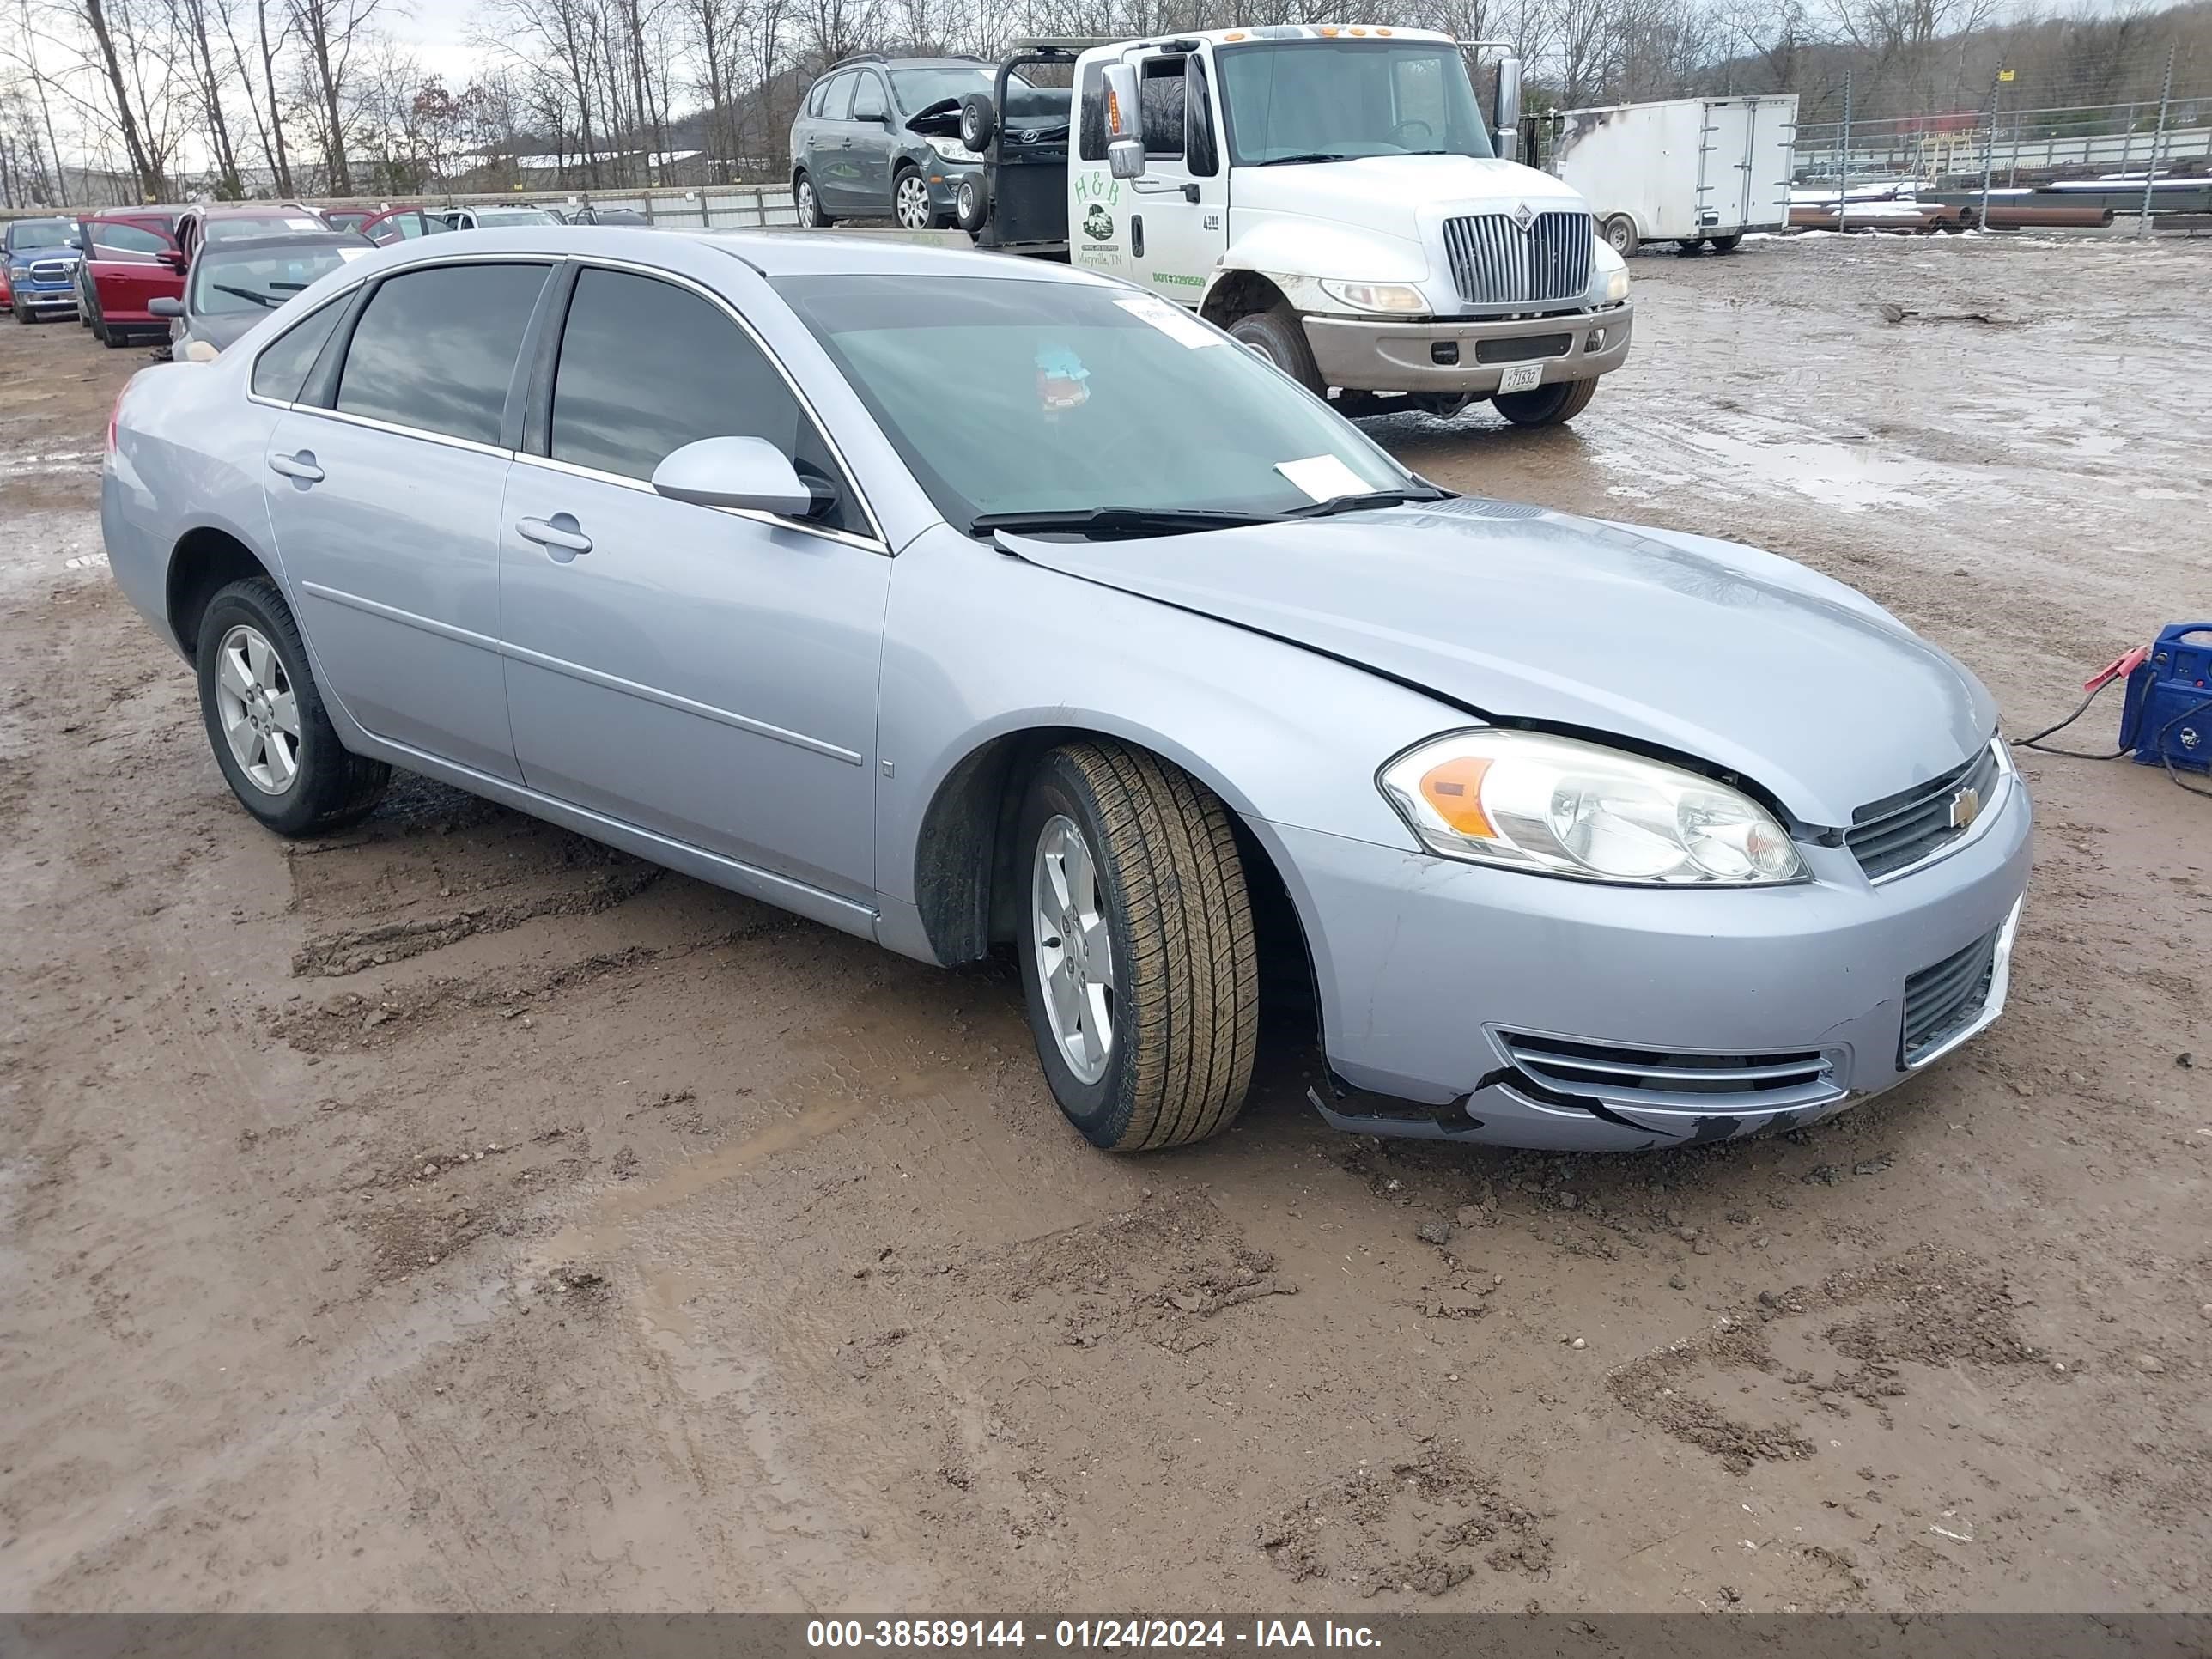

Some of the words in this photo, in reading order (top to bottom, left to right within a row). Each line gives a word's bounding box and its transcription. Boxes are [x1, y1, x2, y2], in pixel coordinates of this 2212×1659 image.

[1073, 175, 1087, 206] H
[1091, 171, 1103, 196] &
[1107, 179, 1119, 206] B
